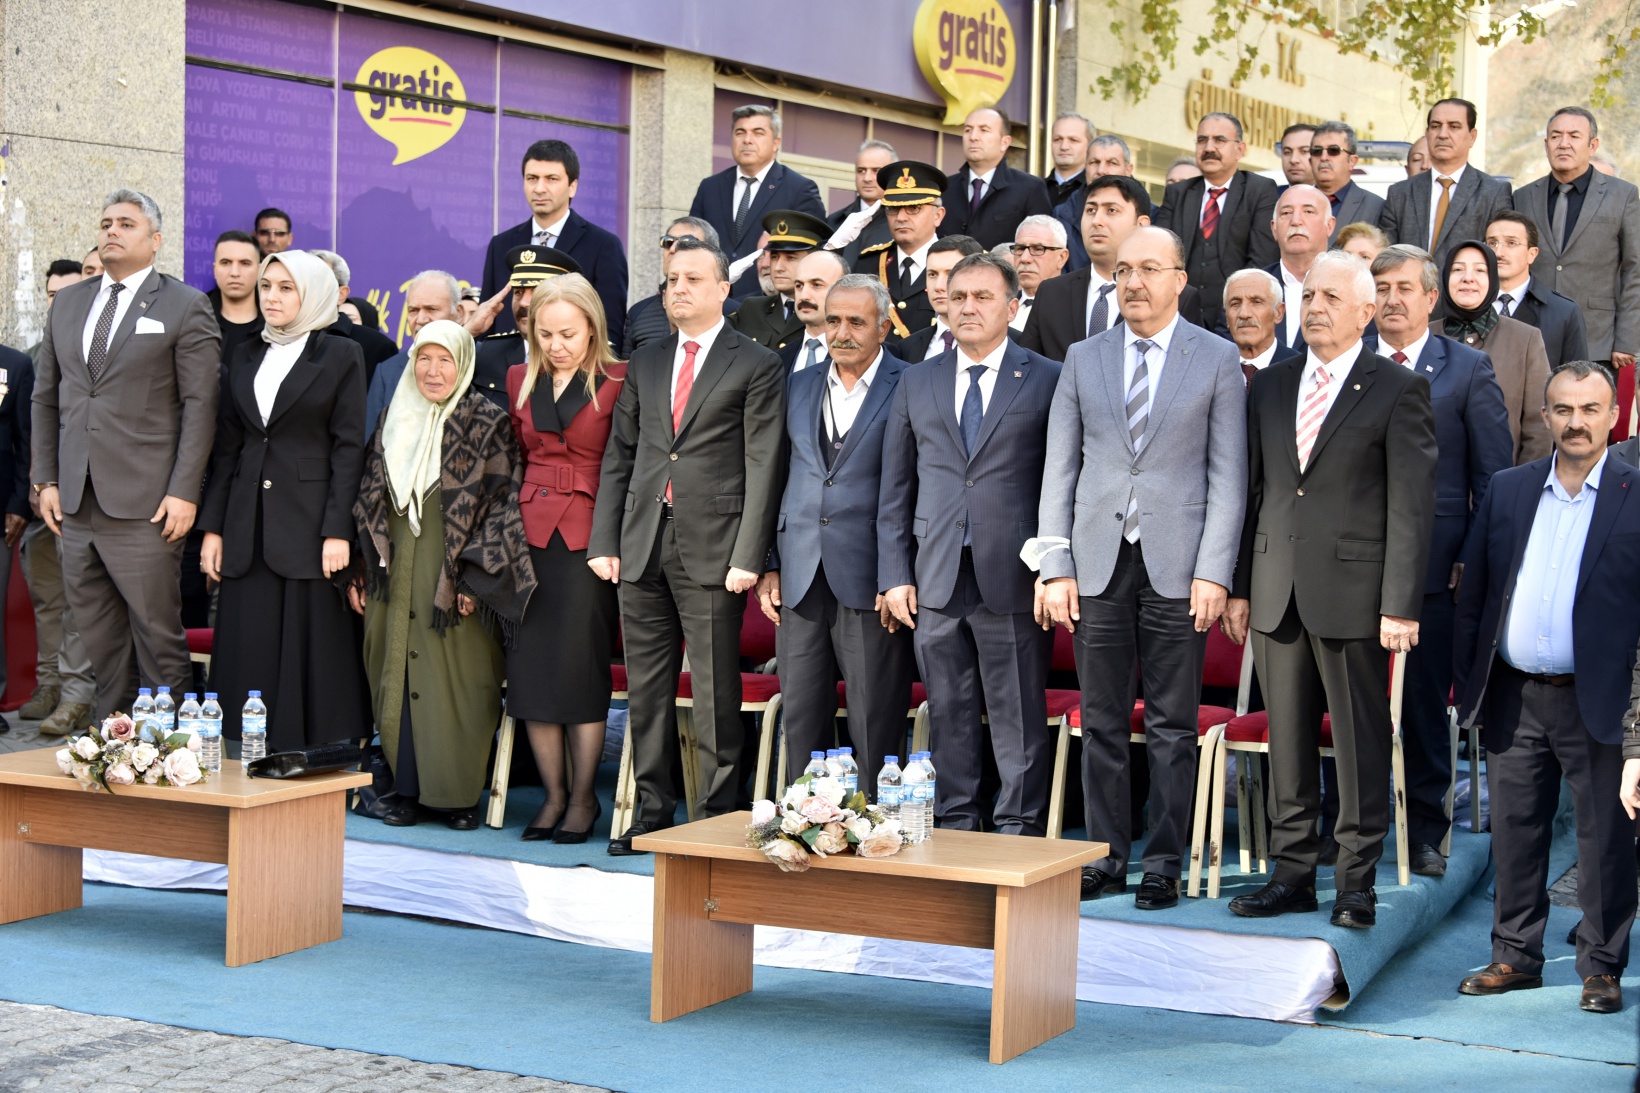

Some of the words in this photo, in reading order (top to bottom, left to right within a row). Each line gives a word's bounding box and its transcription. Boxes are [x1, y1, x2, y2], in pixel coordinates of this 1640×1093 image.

[938, 7, 1006, 71] gratis
[226, 79, 273, 101] YOZGAT
[369, 65, 455, 120] gratis
[211, 100, 257, 122] ARTVİN
[265, 108, 300, 128] AYDIN
[220, 124, 270, 145] ÇANKIRI
